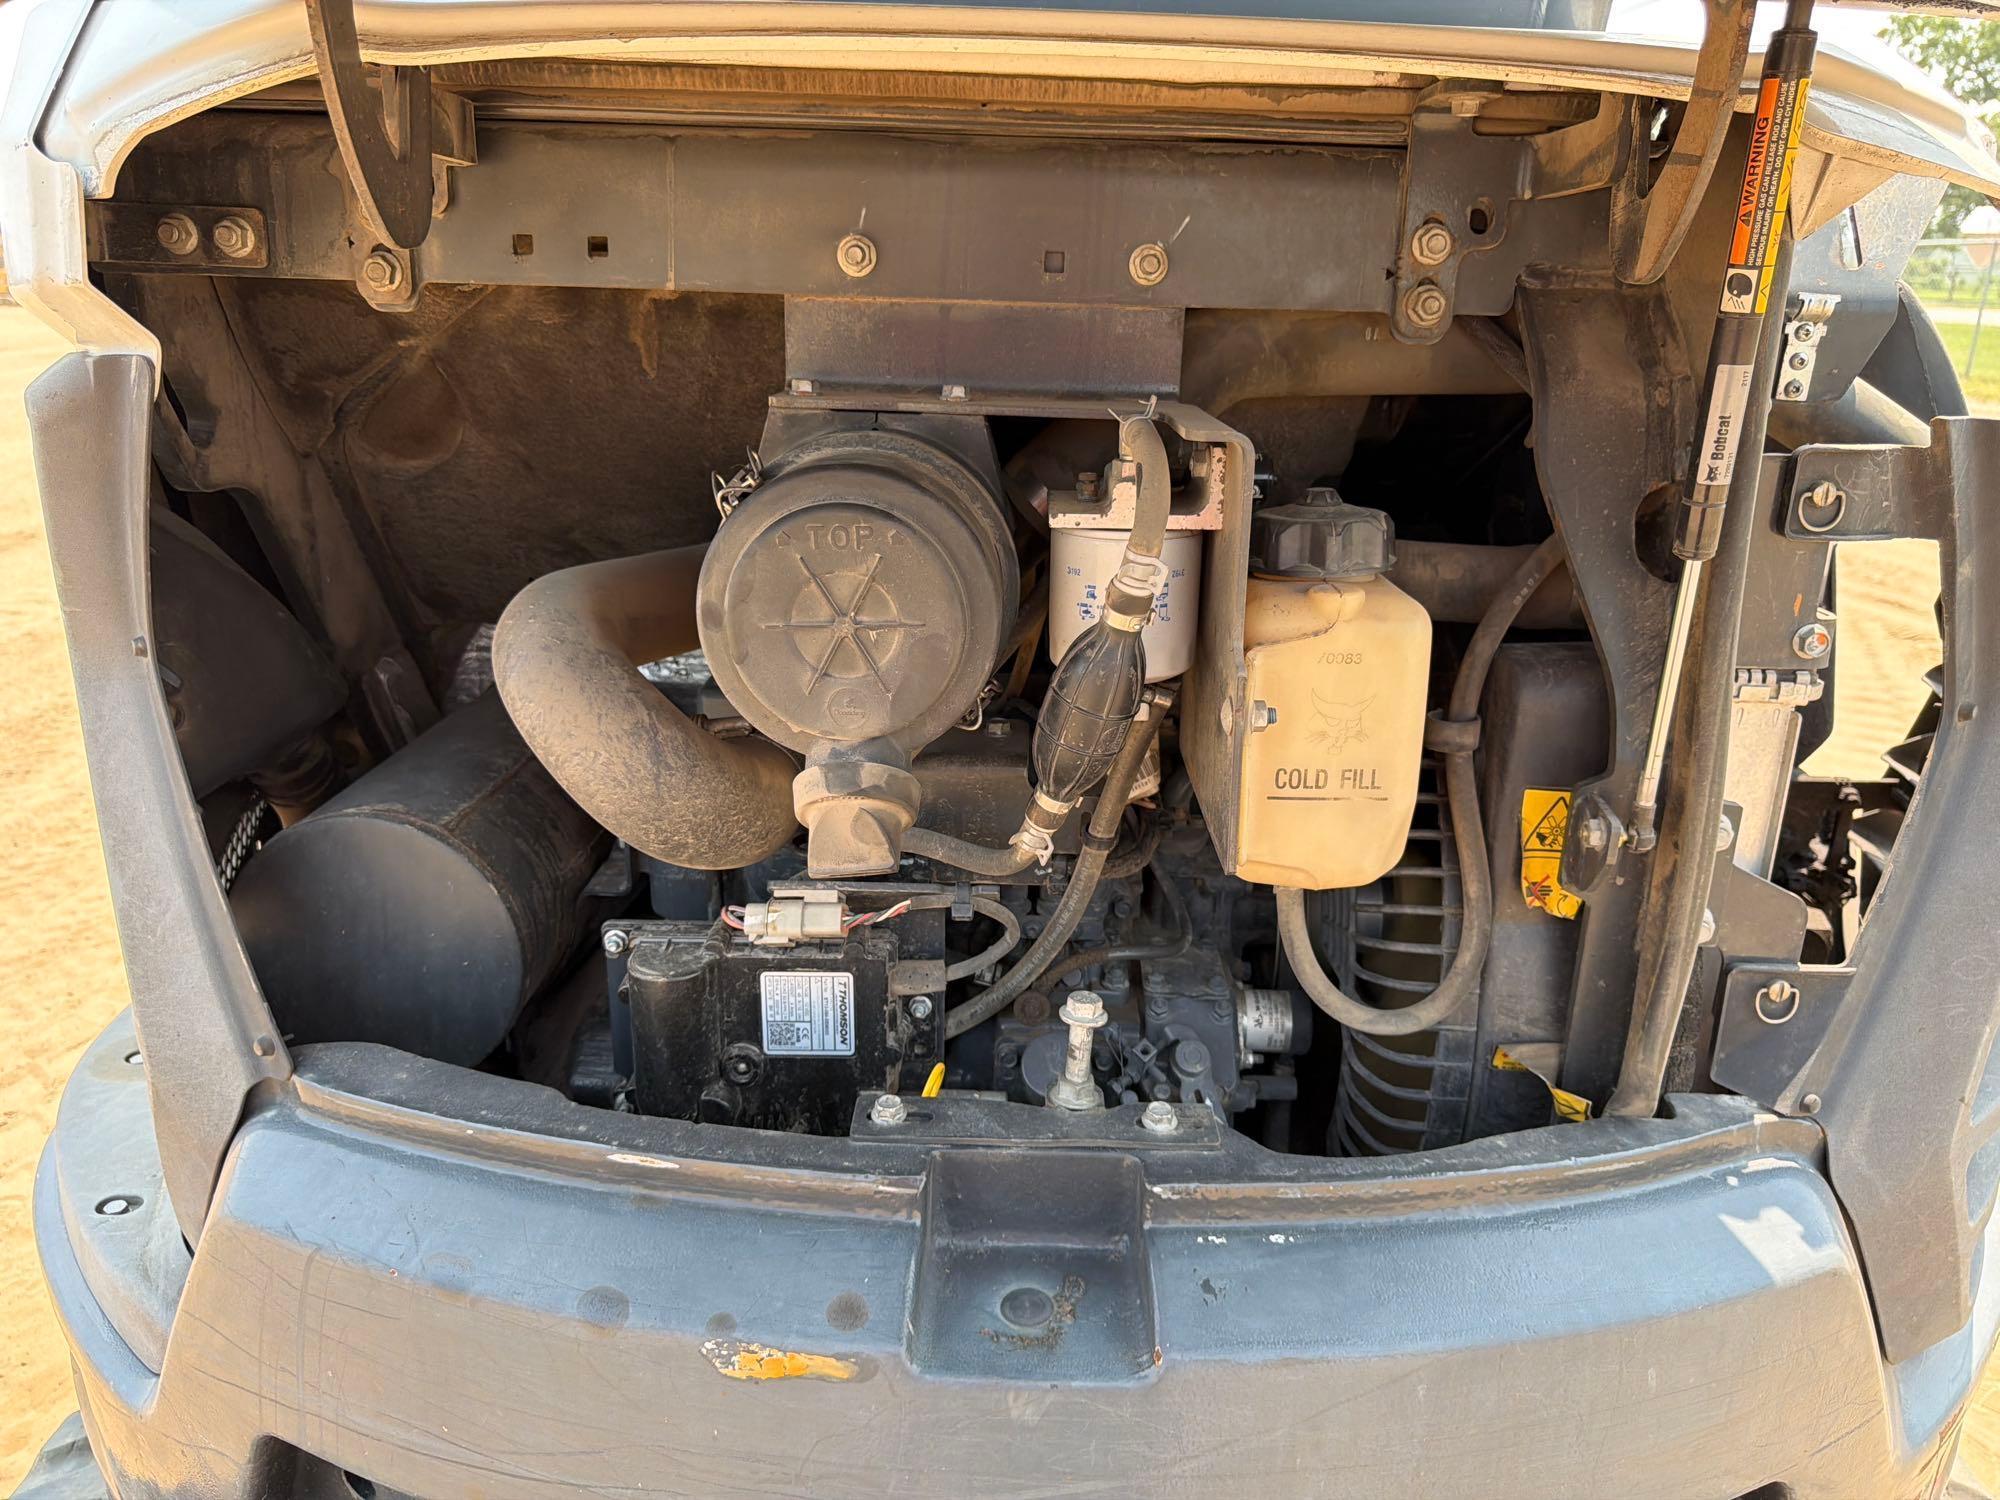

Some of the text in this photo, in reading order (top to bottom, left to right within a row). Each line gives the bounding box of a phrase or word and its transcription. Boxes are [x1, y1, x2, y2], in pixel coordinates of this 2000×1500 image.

[1785, 79, 1797, 117] CYLINDER.
[1781, 117, 1790, 139] OPEN
[1778, 138, 1787, 155] NOT
[1743, 116, 1770, 207] WARNING
[1747, 82, 1789, 266] HIGH PRESSURE GAS CAN RELEASE ROD AND CAUSE
[1774, 156, 1782, 168] DO
[1766, 195, 1775, 207] OR
[1762, 208, 1772, 234] INJURY
[1755, 234, 1767, 266] SERIOUS
[1711, 415, 1731, 461] Bobcat
[805, 523, 874, 551] TOP
[1274, 768, 1382, 790] COLD FILL
[839, 989, 848, 1046] THOMSON
